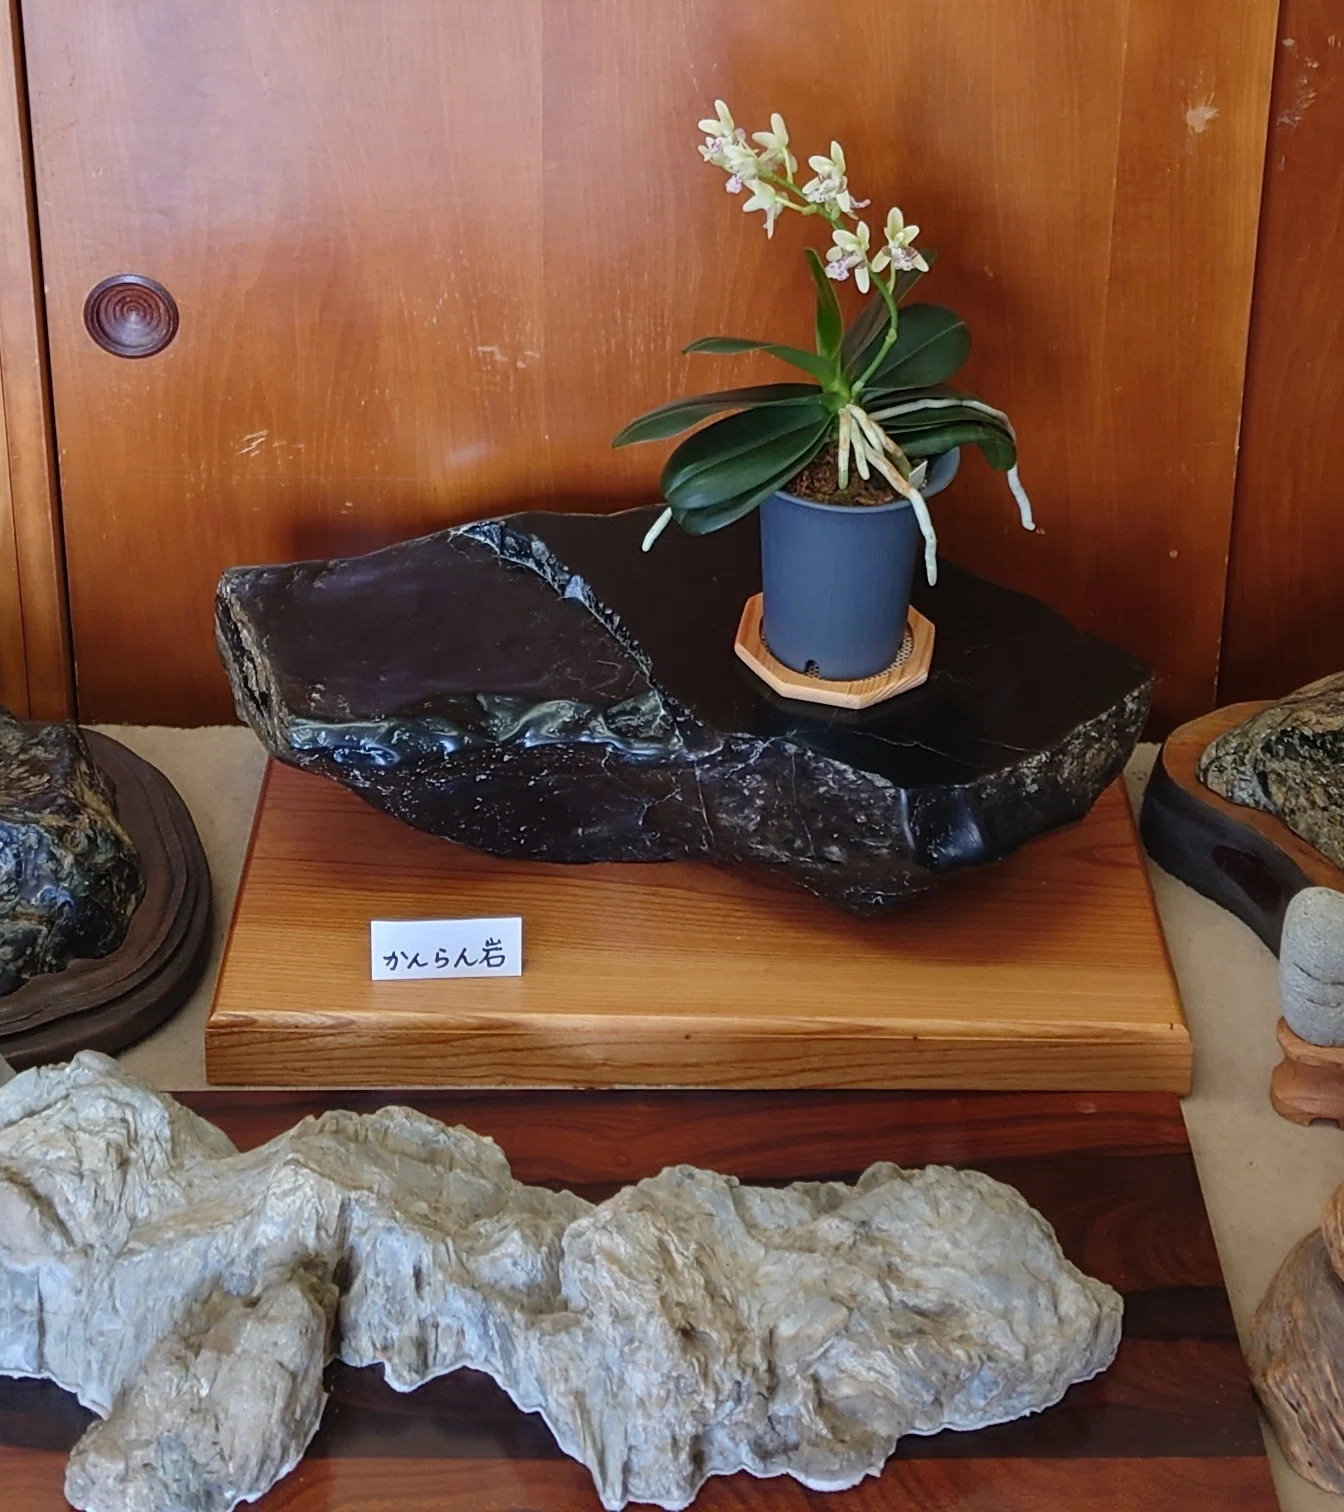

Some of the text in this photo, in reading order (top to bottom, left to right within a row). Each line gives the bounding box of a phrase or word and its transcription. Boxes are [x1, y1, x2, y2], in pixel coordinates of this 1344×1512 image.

[383, 937, 506, 971] かんらん岩
